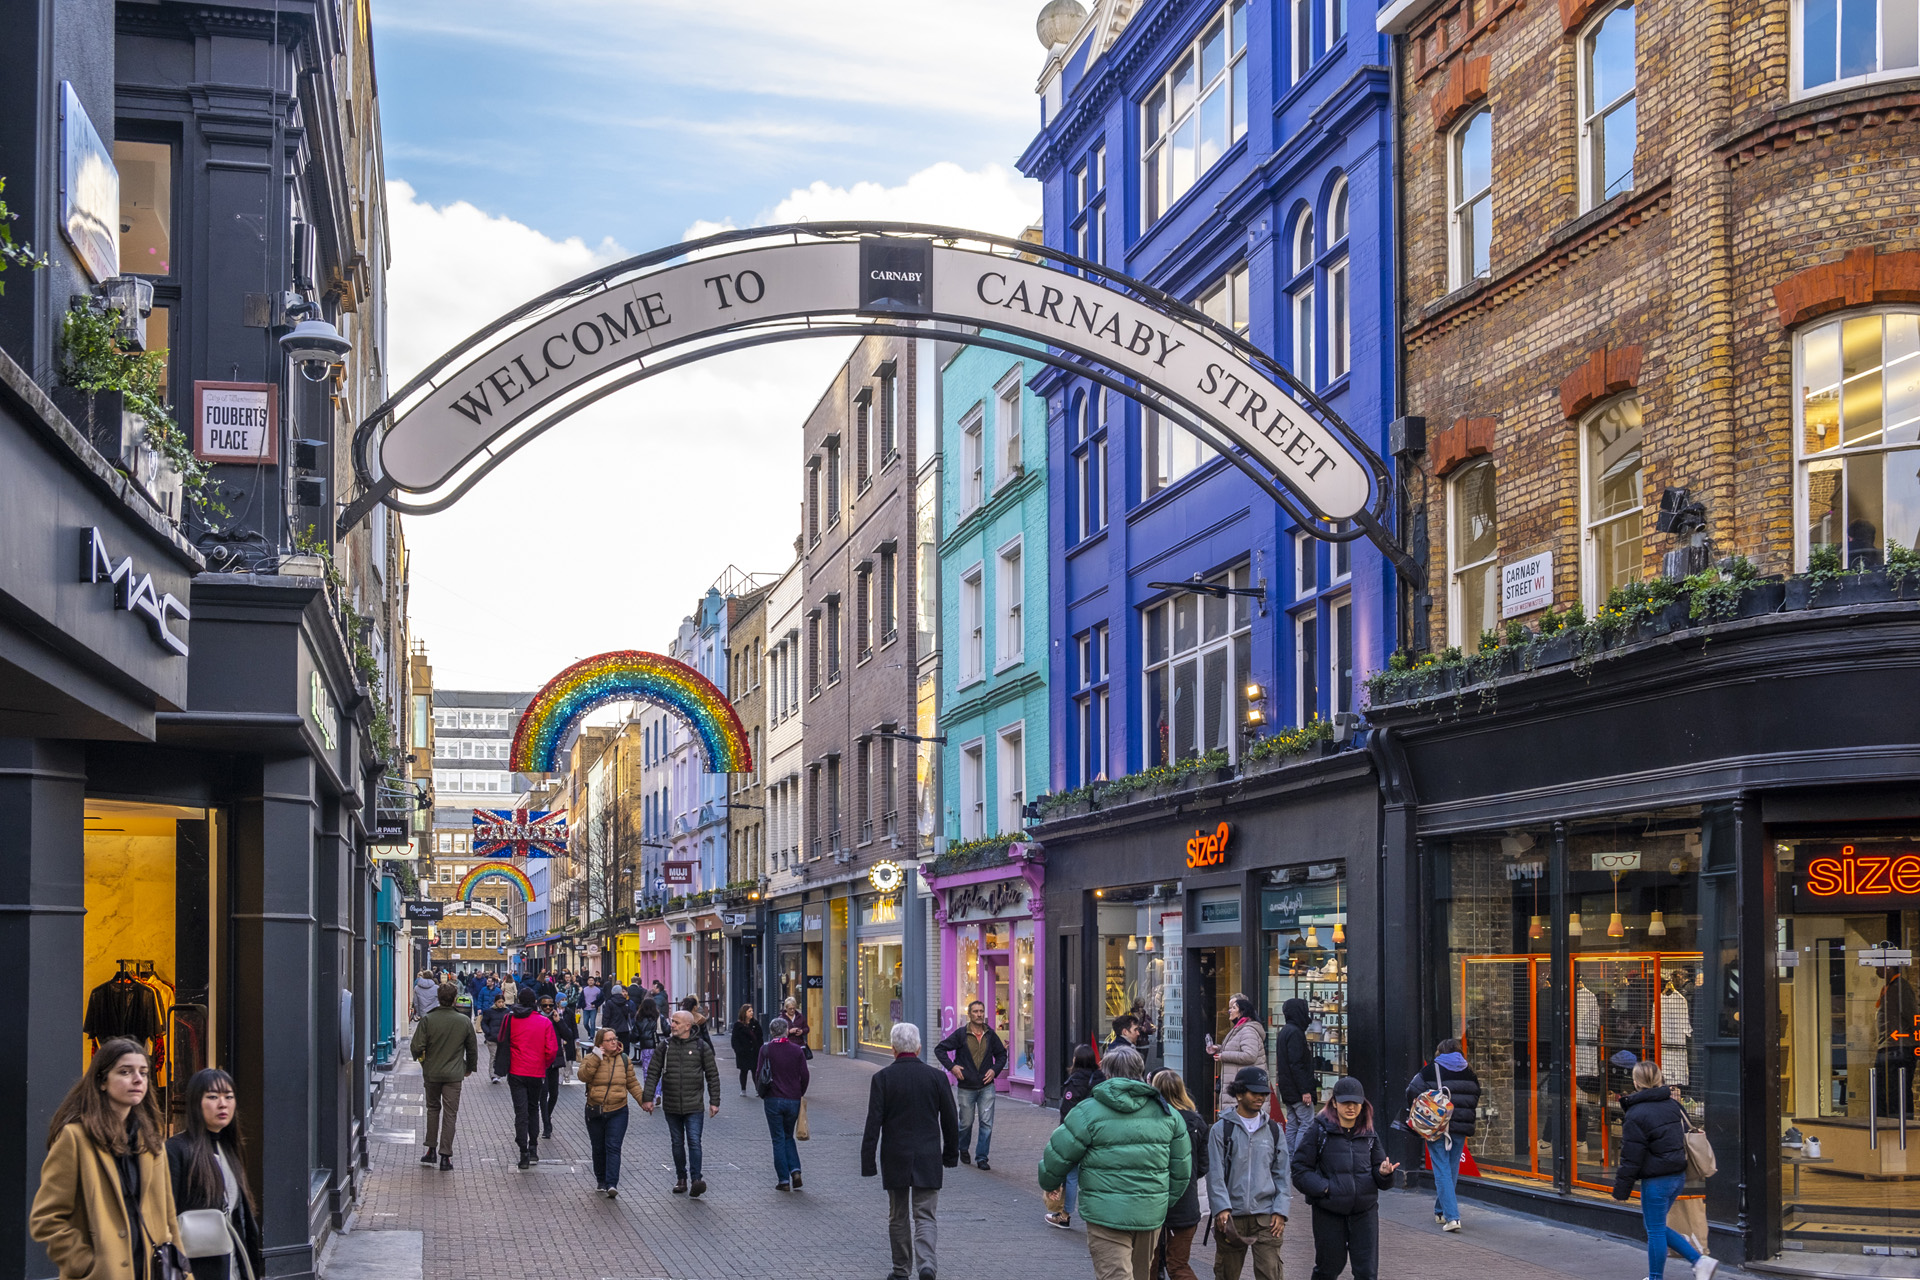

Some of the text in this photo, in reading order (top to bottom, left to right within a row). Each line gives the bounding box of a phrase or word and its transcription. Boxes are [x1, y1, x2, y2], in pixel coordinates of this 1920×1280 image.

[871, 270, 922, 281] CARNABY
[449, 270, 1337, 483] WELCOME TO CARNABY STREET
[207, 406, 267, 427] FOUBERT'S
[210, 429, 248, 450] PLACE
[1507, 561, 1540, 583] CARNABY
[1507, 575, 1545, 599] STREET W1
[1520, 598, 1543, 609] WESTMINSTER
[476, 824, 568, 840] CARNABY
[1186, 821, 1229, 868] size?
[669, 867, 688, 876] MUJI
[409, 904, 422, 914] Pepe
